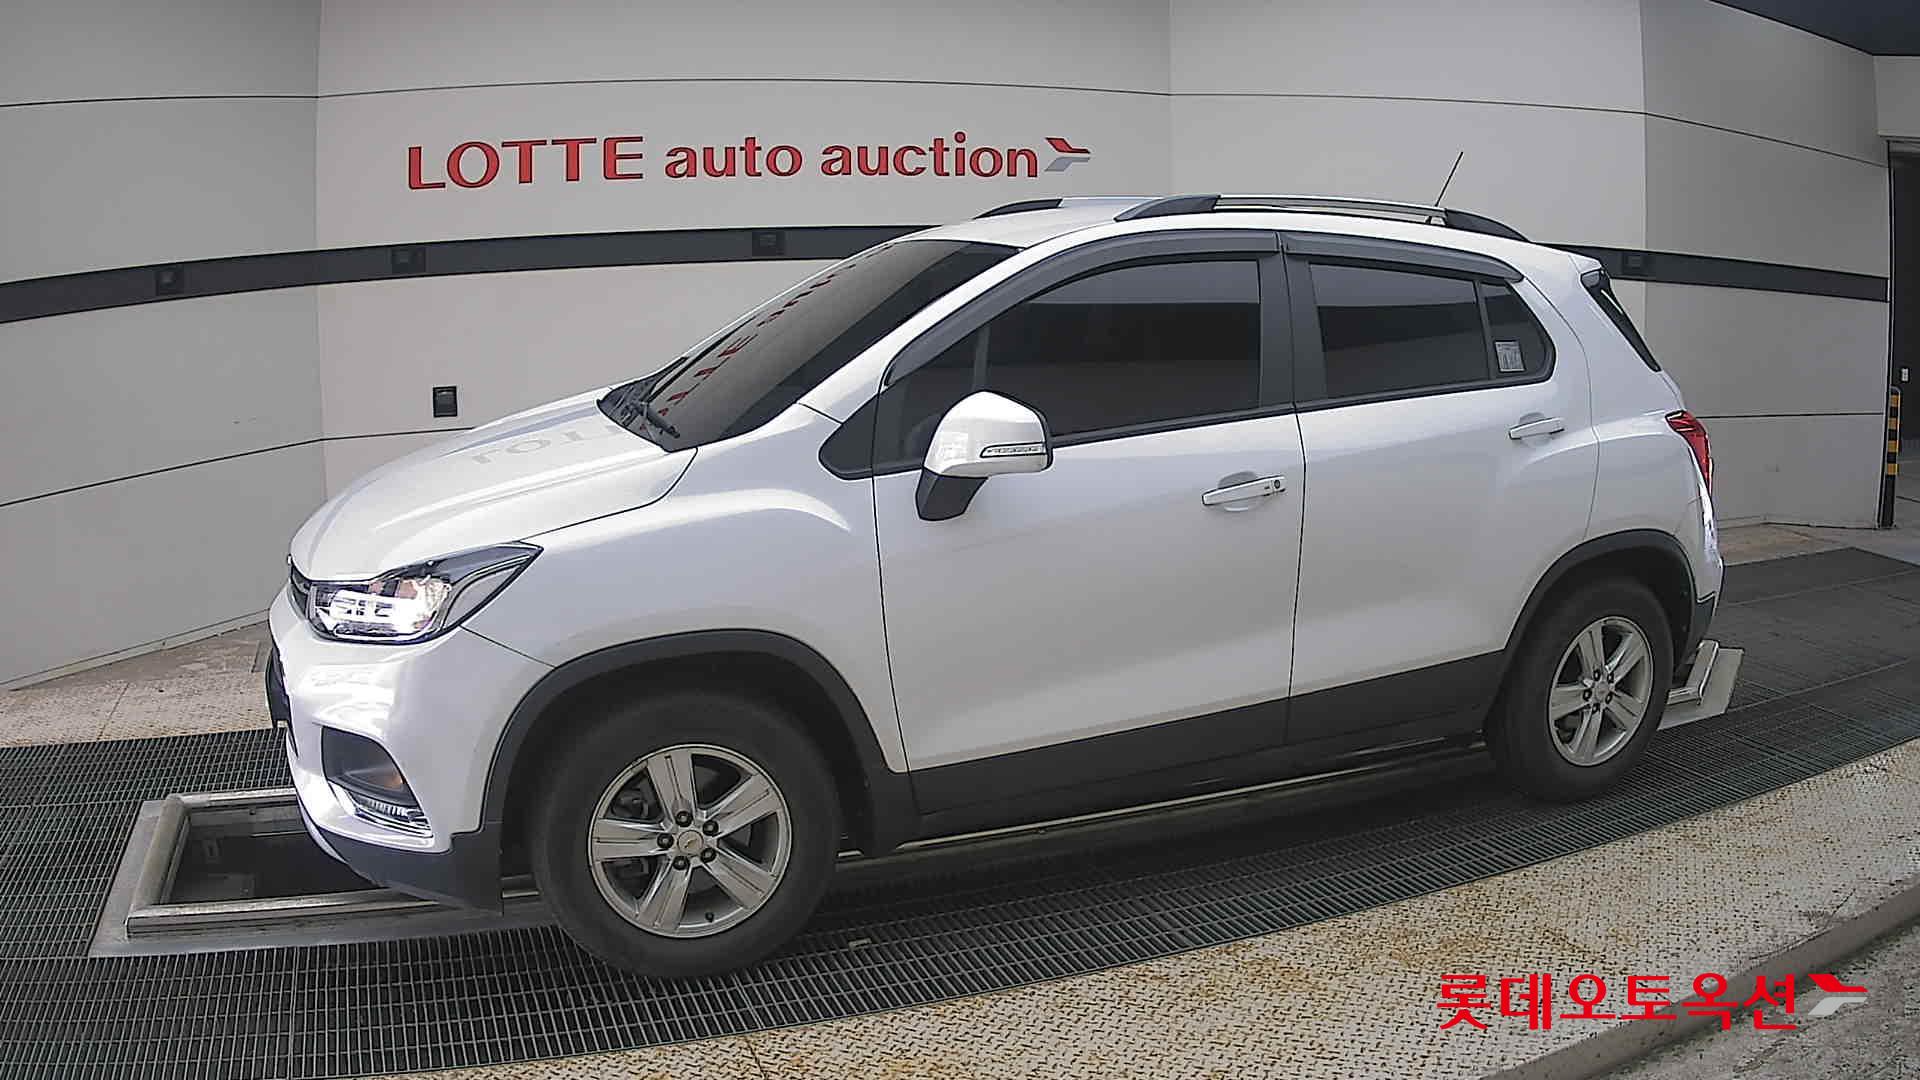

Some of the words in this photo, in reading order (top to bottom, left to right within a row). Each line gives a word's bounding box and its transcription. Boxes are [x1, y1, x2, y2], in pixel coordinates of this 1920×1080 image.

[407, 135, 644, 190] LOTTE
[664, 136, 803, 178] auto
[819, 131, 1039, 178] auction
